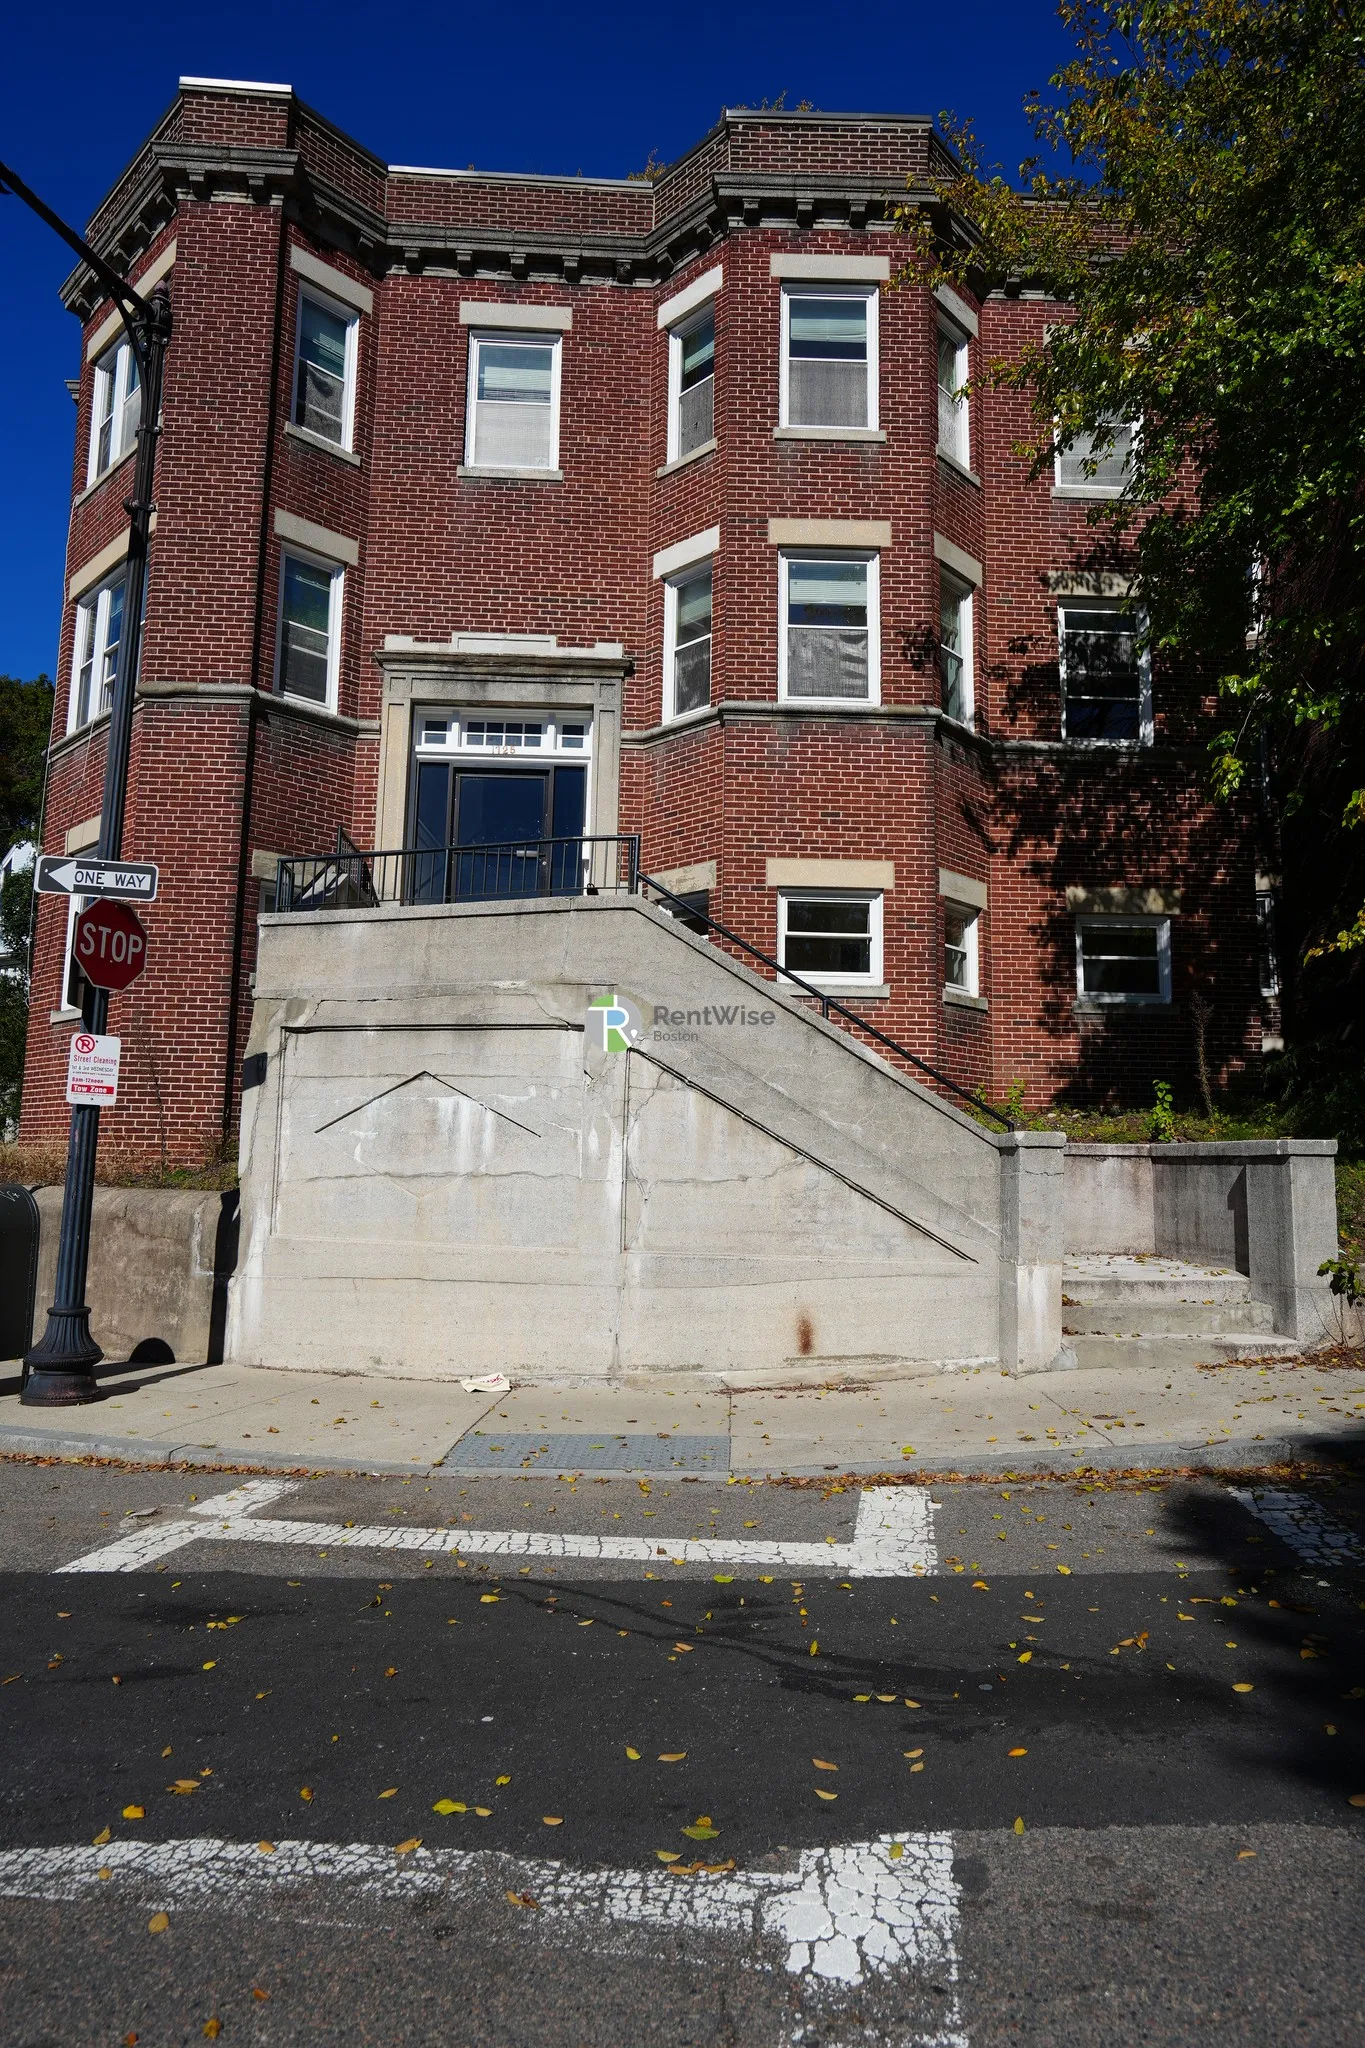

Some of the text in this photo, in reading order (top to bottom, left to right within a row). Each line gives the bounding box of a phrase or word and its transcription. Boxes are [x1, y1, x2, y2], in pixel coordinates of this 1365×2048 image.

[74, 870, 146, 888] ONE WAY
[80, 922, 143, 965] STOP
[94, 1056, 117, 1066] Cleaning
